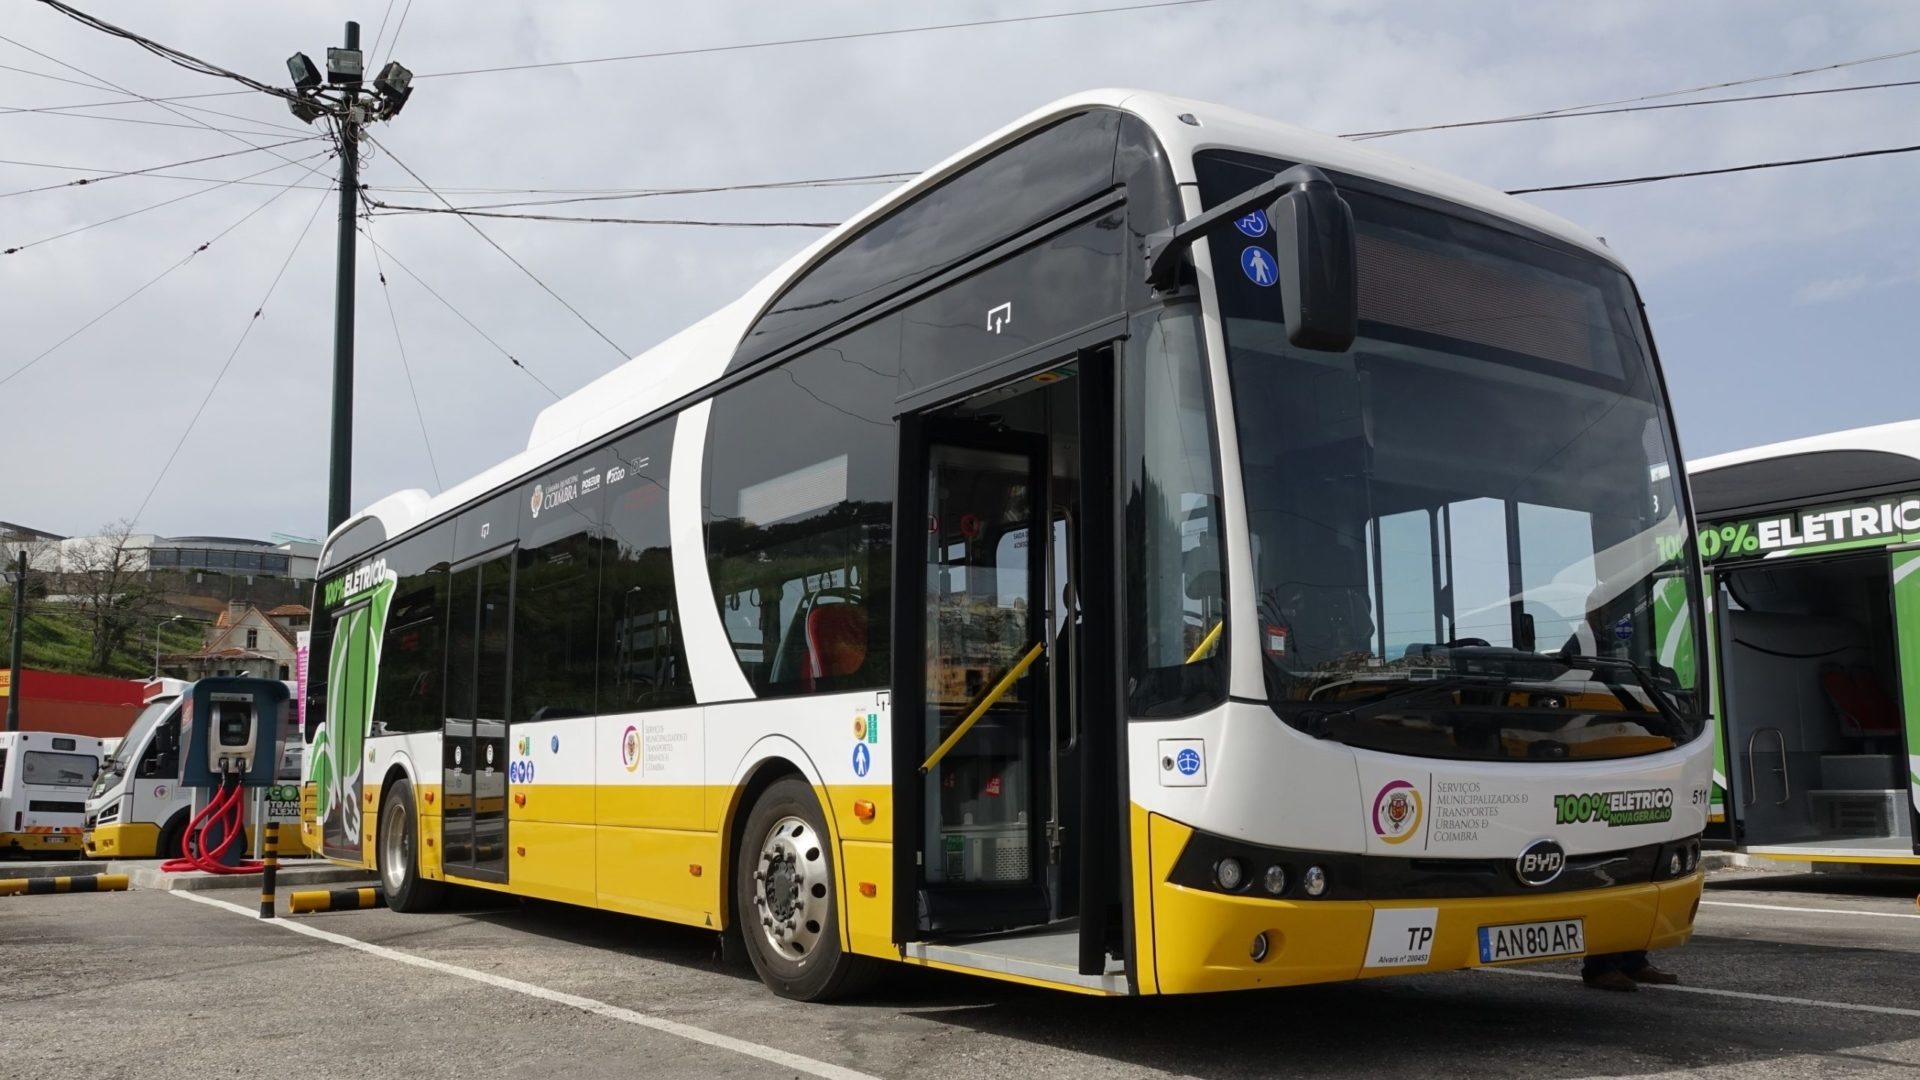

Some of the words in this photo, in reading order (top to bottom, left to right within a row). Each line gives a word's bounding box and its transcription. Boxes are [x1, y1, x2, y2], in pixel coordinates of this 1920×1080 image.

[544, 484, 578, 510] COIMBRA
[1437, 782, 1481, 794] SERVIÇOS
[1436, 794, 1520, 805] MUNICIPALIZADOS
[1692, 789, 1707, 804] 511
[1436, 806, 1498, 817] TRANSPORTES
[1555, 792, 1611, 824] 100%
[1435, 818, 1480, 830] URBANOS
[1433, 831, 1478, 841] COIMBRA
[1523, 852, 1561, 872] BYD
[1408, 927, 1433, 951] TP
